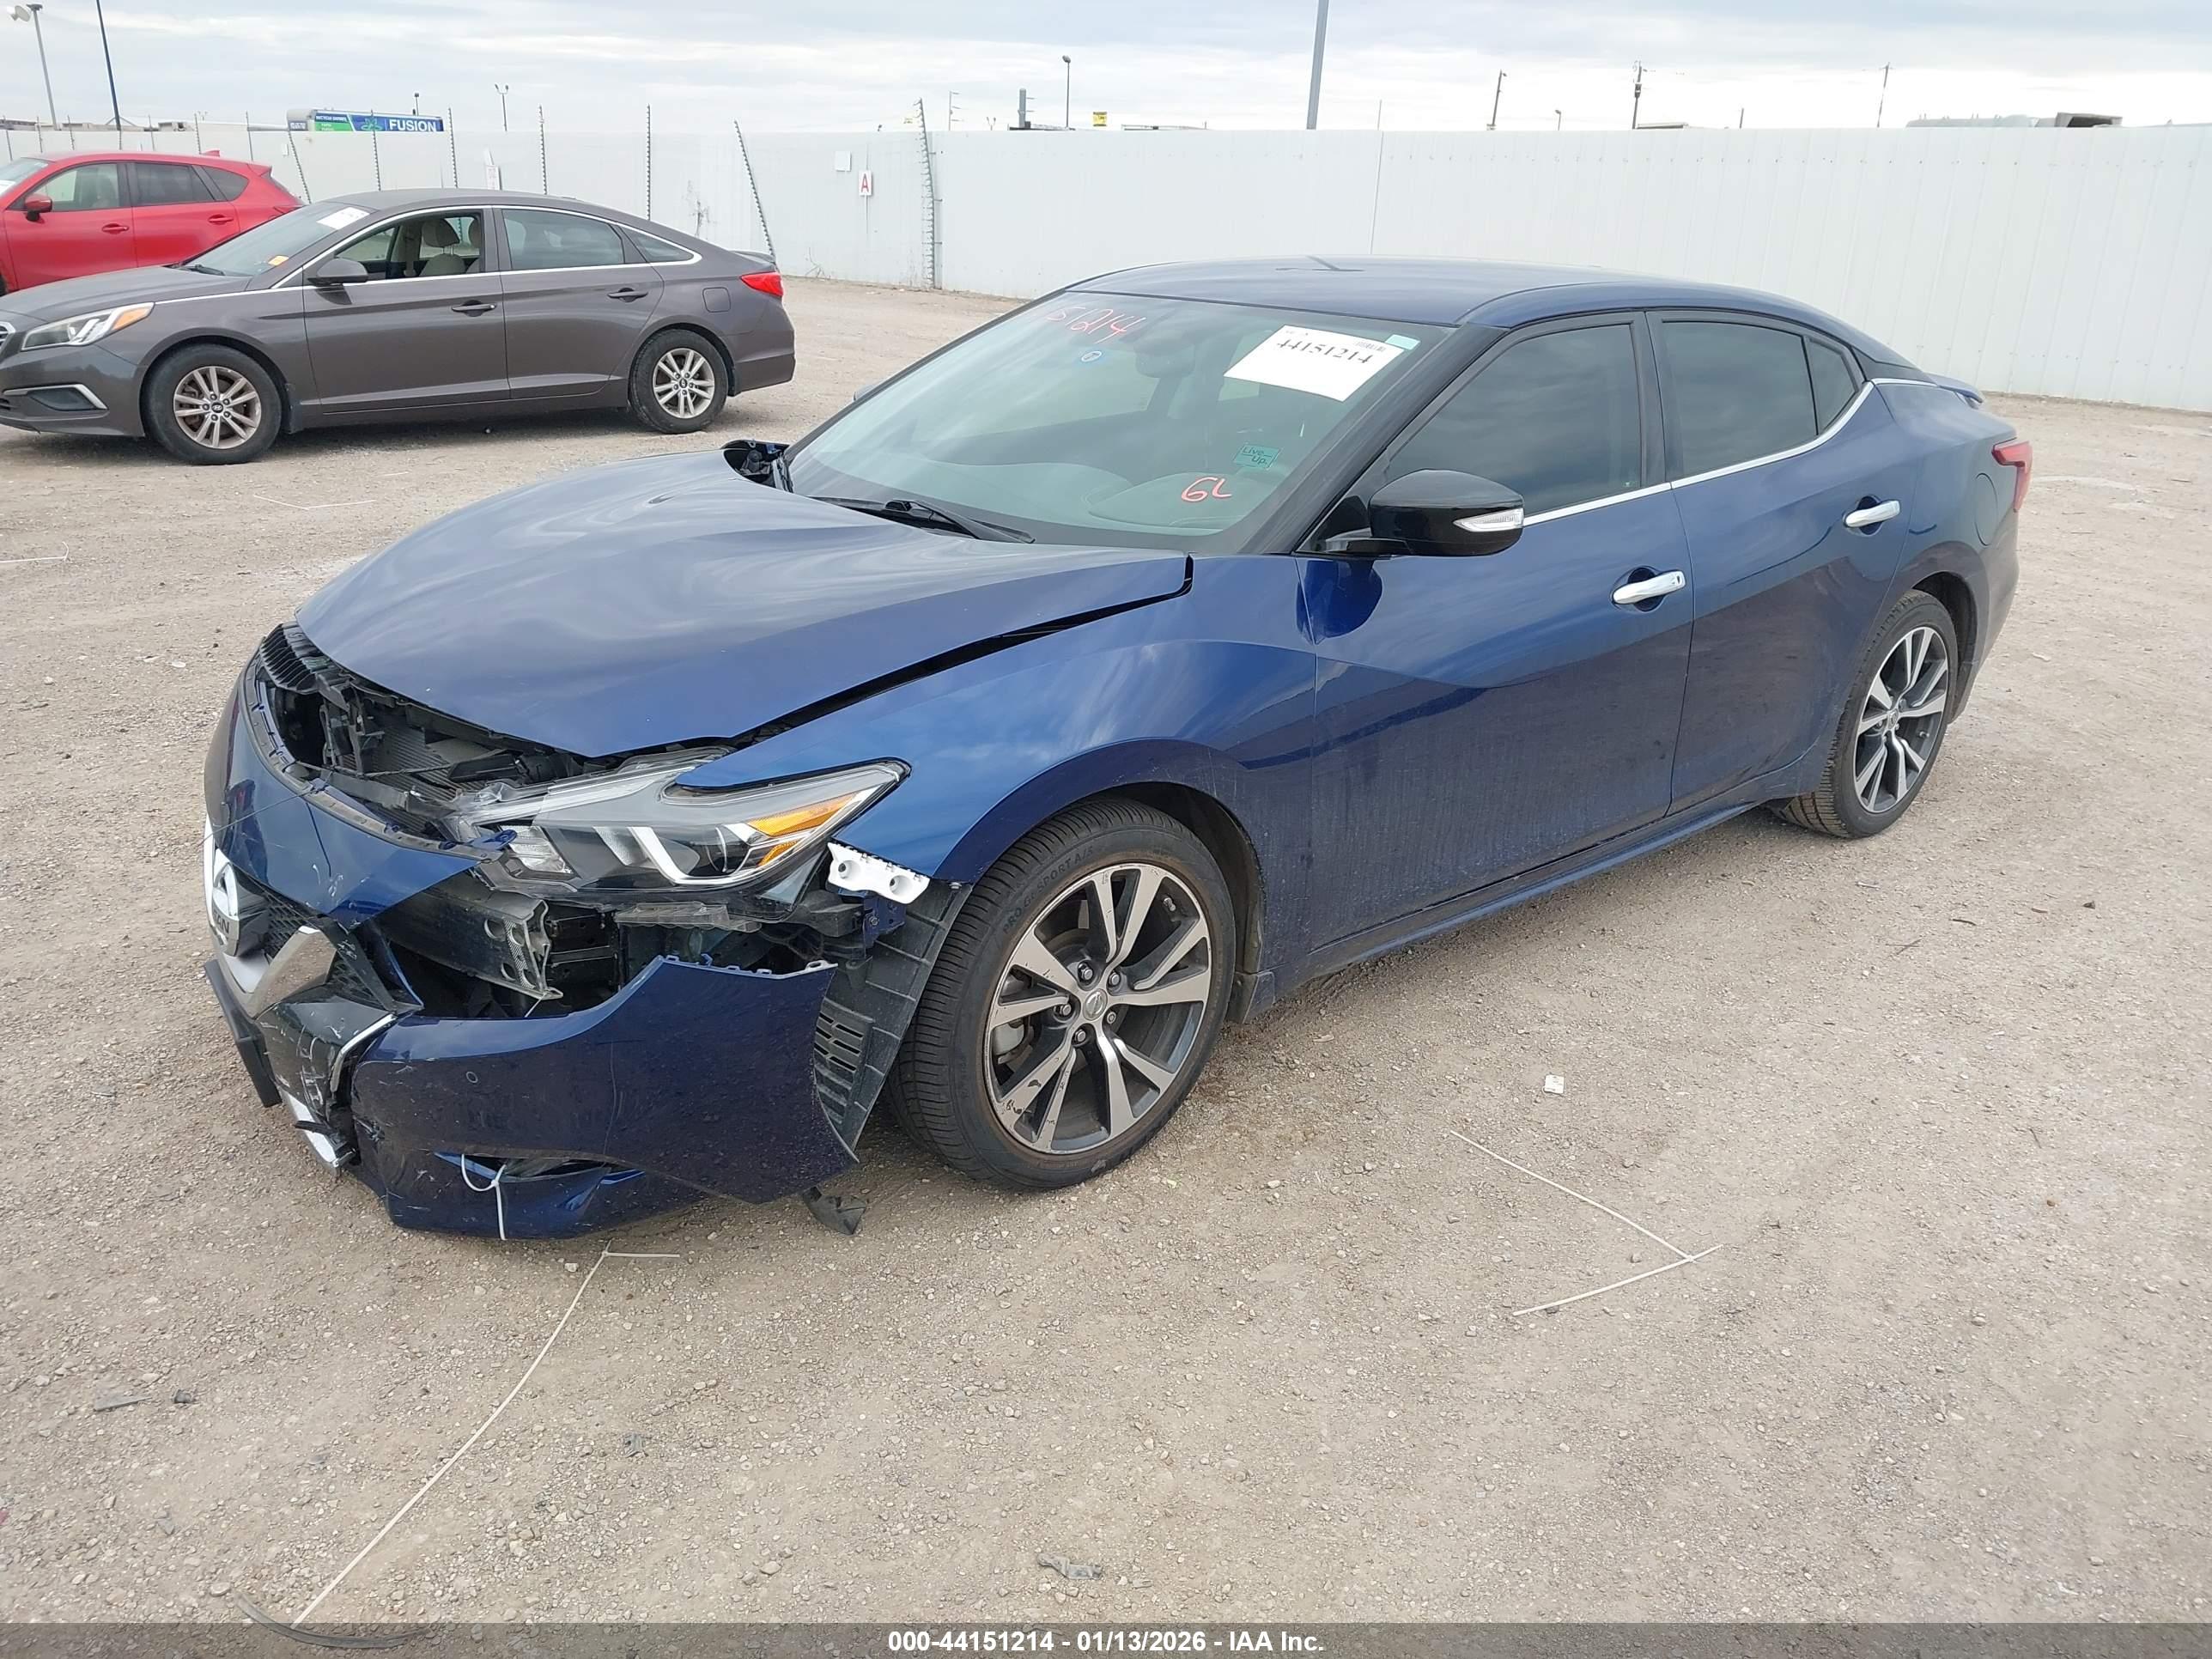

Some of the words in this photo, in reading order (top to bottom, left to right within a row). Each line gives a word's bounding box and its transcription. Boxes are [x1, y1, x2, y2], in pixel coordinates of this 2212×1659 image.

[389, 119, 436, 131] FUSION
[860, 173, 869, 192] A
[1276, 338, 1373, 364] 44151214
[1241, 446, 1266, 456] Live
[1002, 907, 1022, 933] PRO
[1036, 858, 1072, 893] SPORT
[1073, 846, 1094, 864] A/S
